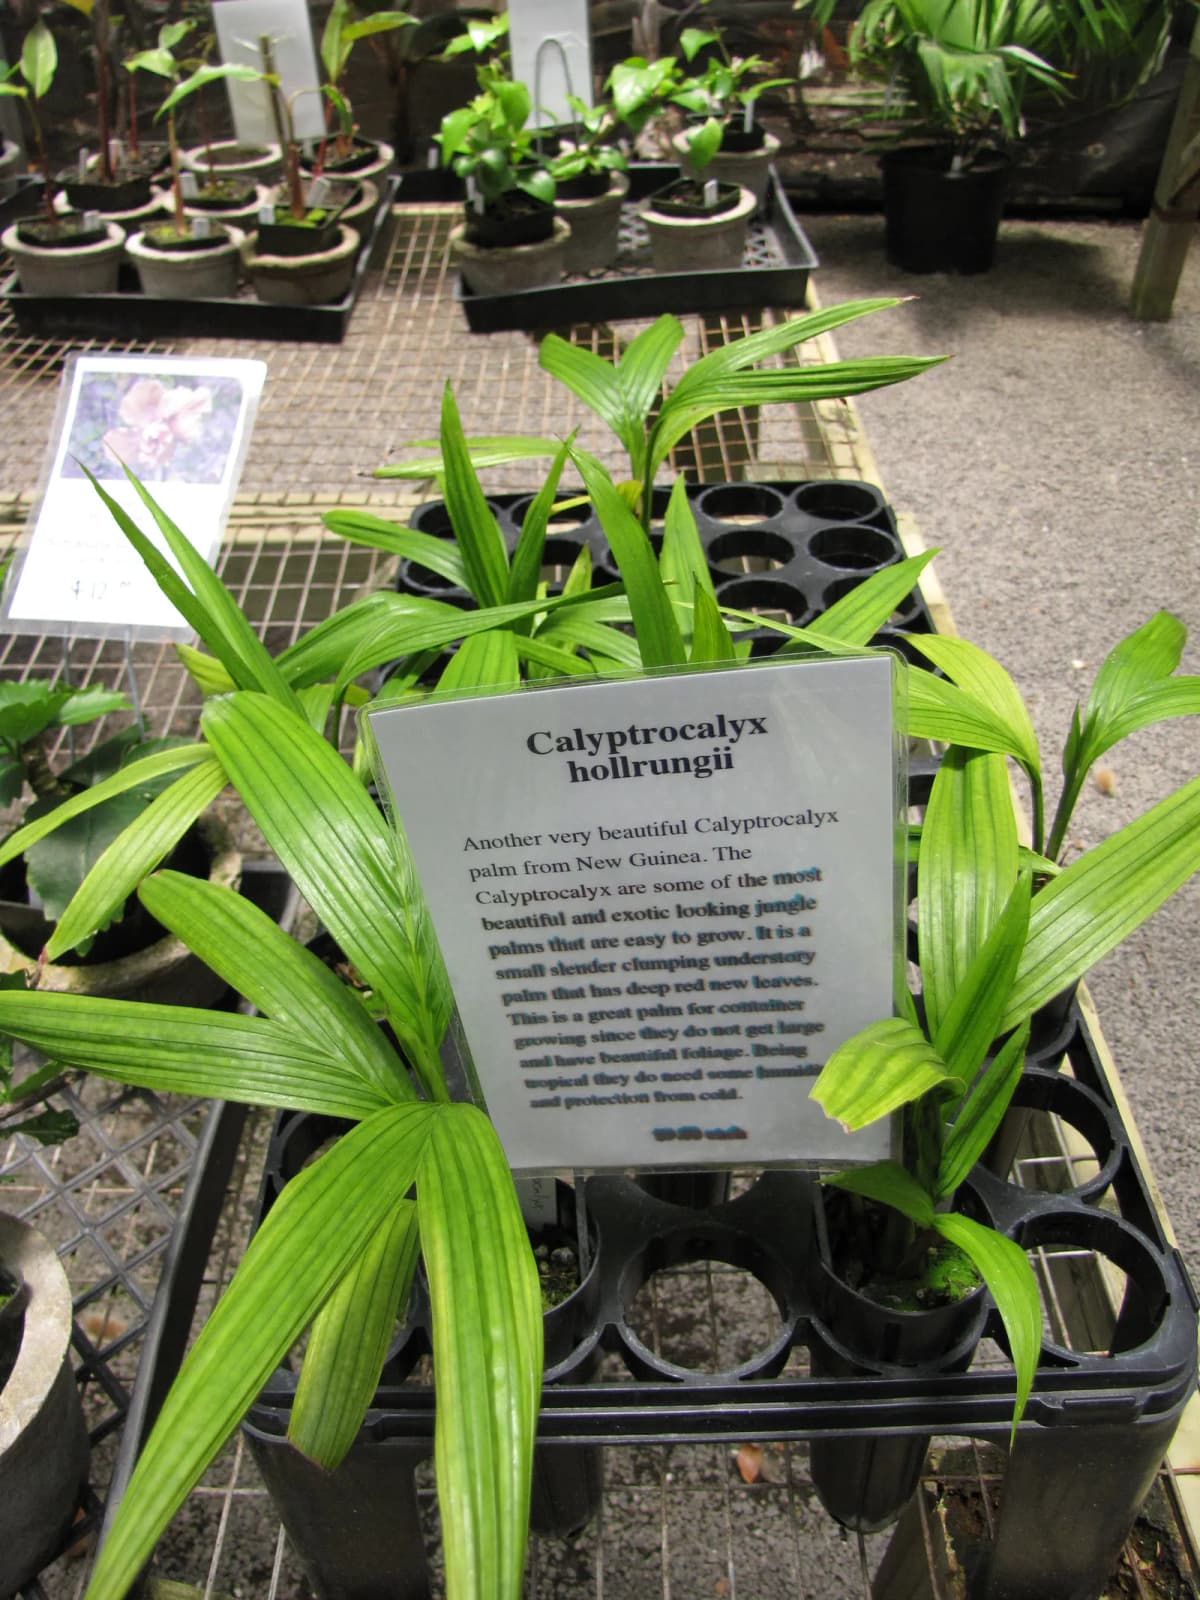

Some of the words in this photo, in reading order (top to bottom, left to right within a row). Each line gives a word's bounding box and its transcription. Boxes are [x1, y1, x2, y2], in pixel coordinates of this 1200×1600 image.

[526, 714, 767, 755] Calyptrocalyx
[568, 747, 734, 783] hollrungii
[463, 833, 541, 851] Another
[547, 831, 590, 845] very
[597, 819, 687, 840] beautiful
[694, 809, 838, 832] Calyptrocalyx
[468, 863, 517, 882] palm
[523, 860, 571, 874] from
[575, 856, 621, 871] New
[628, 850, 707, 866] Guinea.
[712, 845, 751, 861] The
[475, 884, 611, 905] Calyptrocalyx
[617, 883, 646, 895] are
[653, 880, 704, 892] some
[710, 873, 732, 889] of
[737, 872, 767, 887] the
[772, 866, 822, 885] most
[481, 911, 566, 930] beautiful
[571, 908, 606, 925] and
[610, 905, 669, 922] exotic
[675, 901, 750, 918] looking
[754, 894, 816, 914] jungle
[487, 941, 544, 959] palms
[548, 937, 585, 951] that
[590, 937, 619, 949] are
[623, 933, 665, 948] easy
[671, 930, 691, 944] to
[696, 930, 751, 945] grow.
[775, 924, 794, 938] is
[797, 926, 812, 937] a
[495, 963, 545, 979] small
[550, 960, 616, 976] slender
[621, 955, 710, 971] clumping
[713, 950, 815, 966] understory
[500, 989, 547, 1006] palm
[551, 986, 585, 1000] that
[589, 984, 621, 997] has
[625, 982, 670, 997] deep
[674, 978, 705, 992] red
[708, 979, 747, 991] new
[505, 1012, 548, 1025] This
[551, 1011, 568, 1023] is
[572, 1012, 583, 1022] a
[588, 1007, 631, 1023] great
[636, 1003, 683, 1020] palm
[686, 1002, 714, 1015] for
